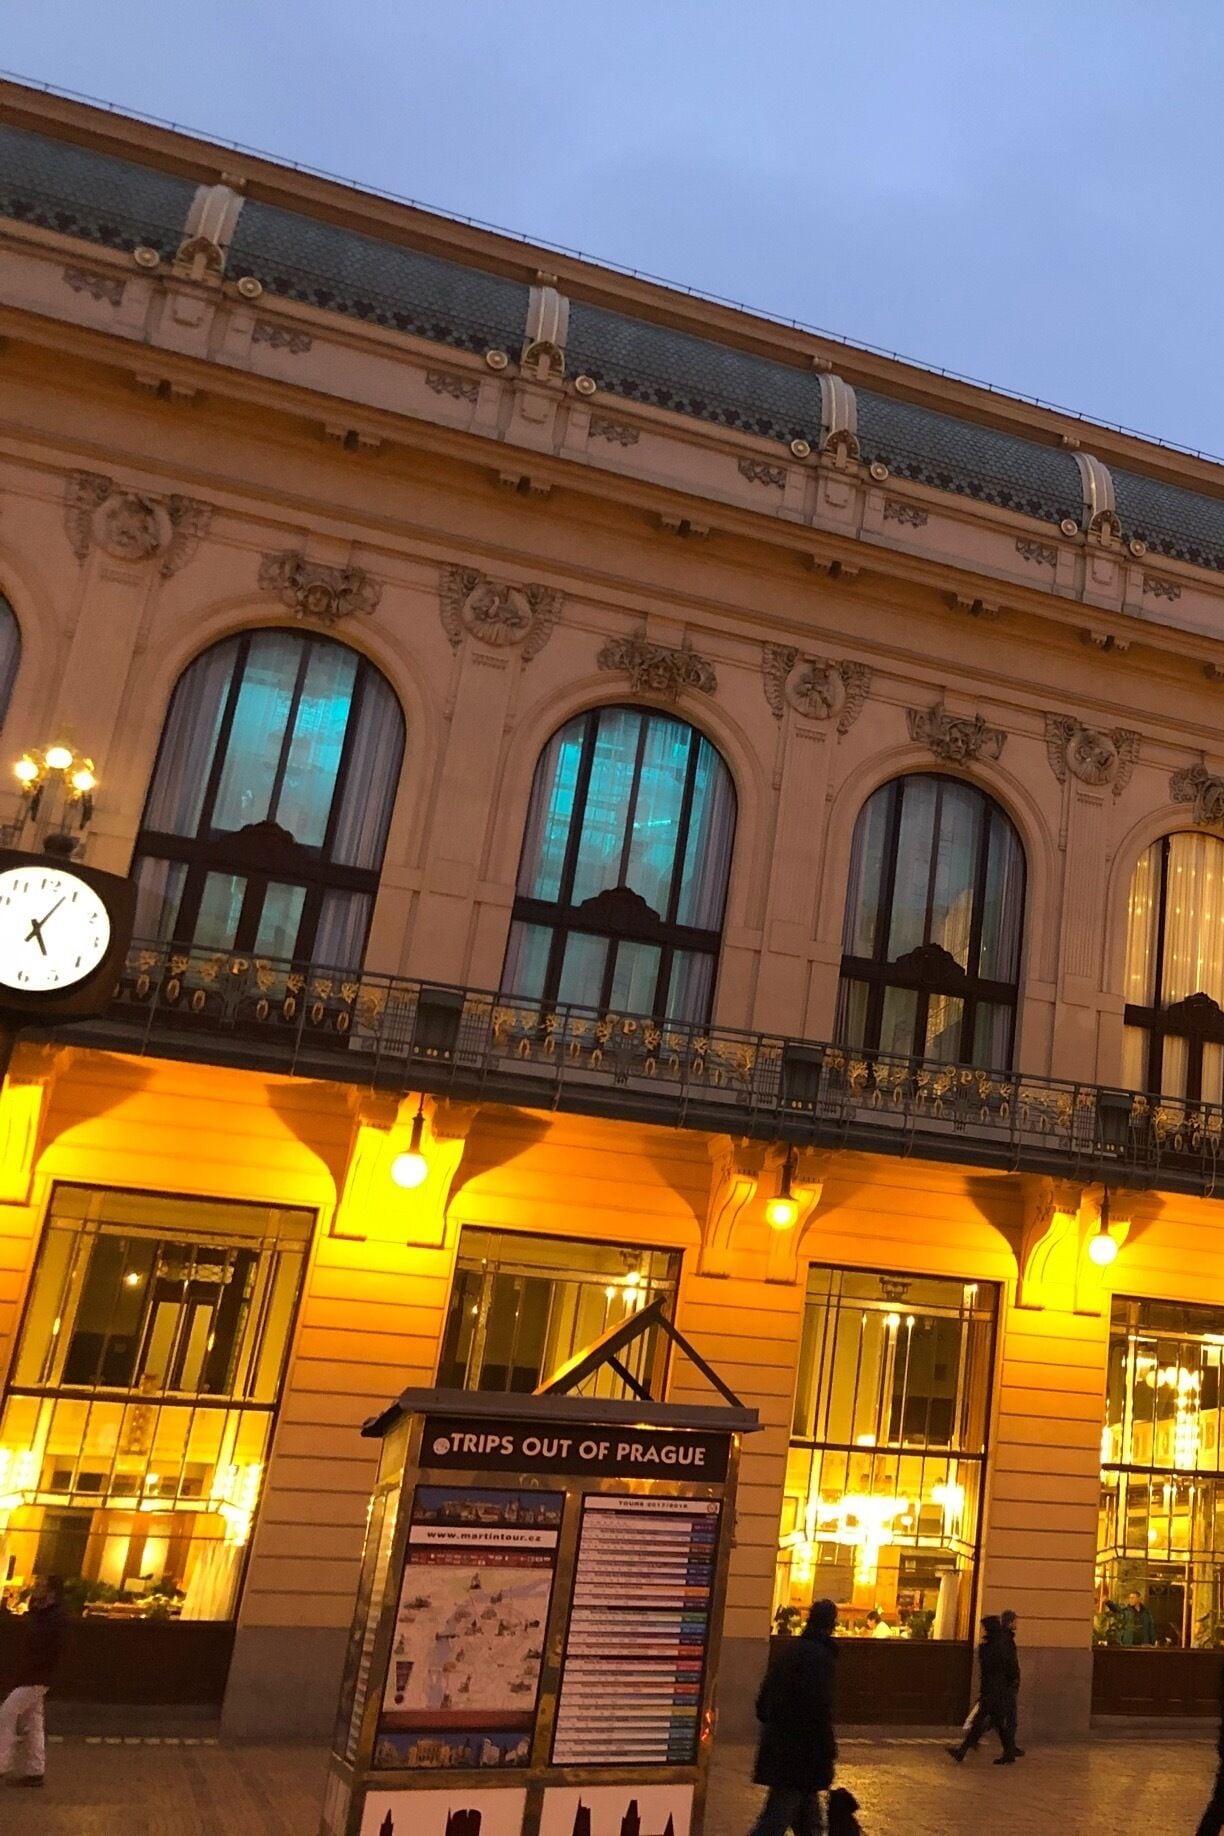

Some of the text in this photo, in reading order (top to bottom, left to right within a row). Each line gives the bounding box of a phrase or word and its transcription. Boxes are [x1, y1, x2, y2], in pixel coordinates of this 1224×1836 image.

[451, 1433, 706, 1466] TRIPS OUT OF PRAGUE
[427, 1531, 542, 1543] www.martintour.cz
